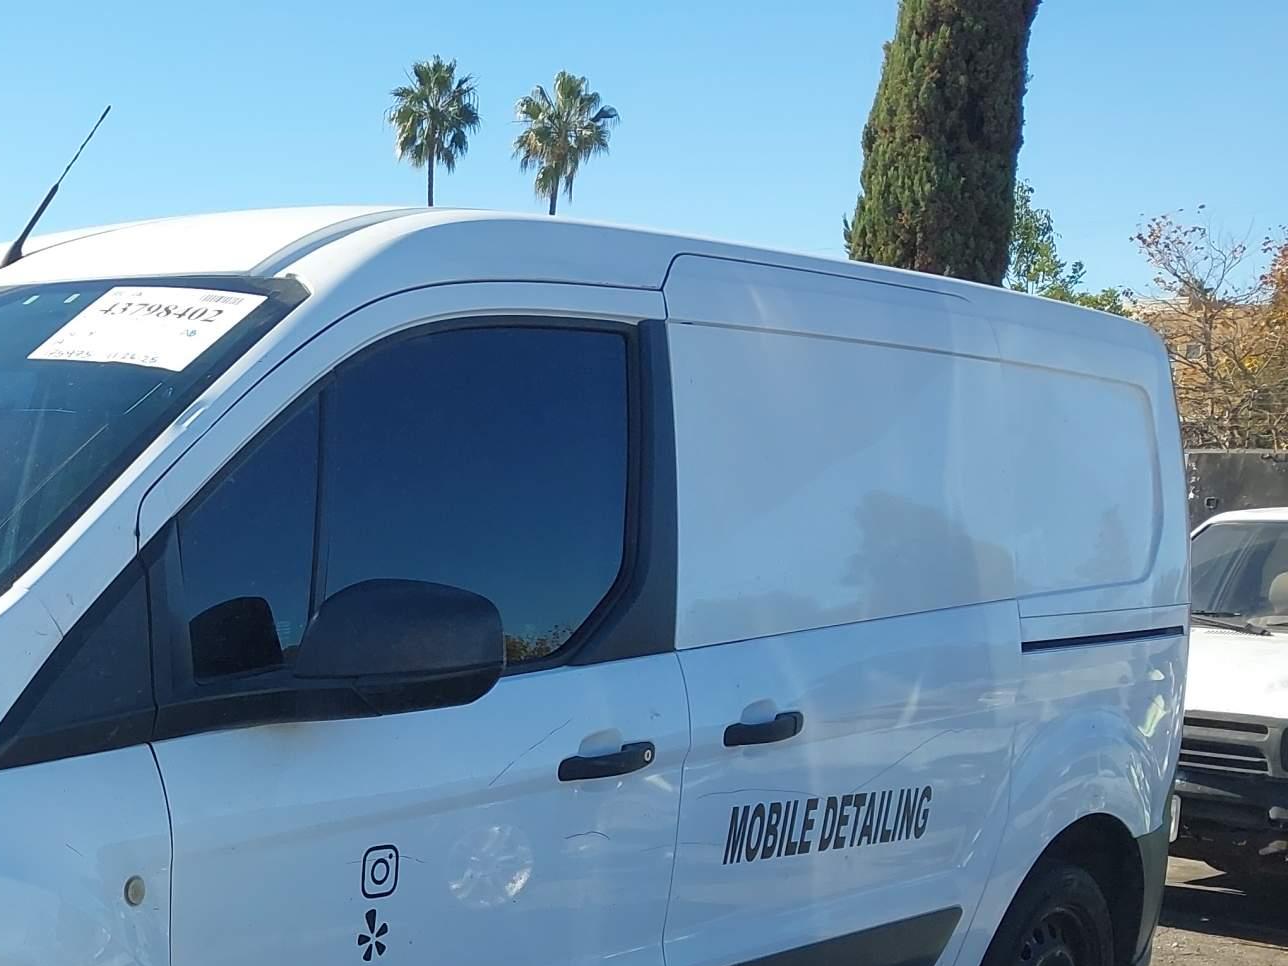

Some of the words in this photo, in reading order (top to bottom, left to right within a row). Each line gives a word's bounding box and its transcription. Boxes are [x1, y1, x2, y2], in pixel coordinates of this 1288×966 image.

[99, 302, 224, 323] 43798402
[722, 798, 819, 865] MOBILE
[818, 785, 933, 852] DETAILING
